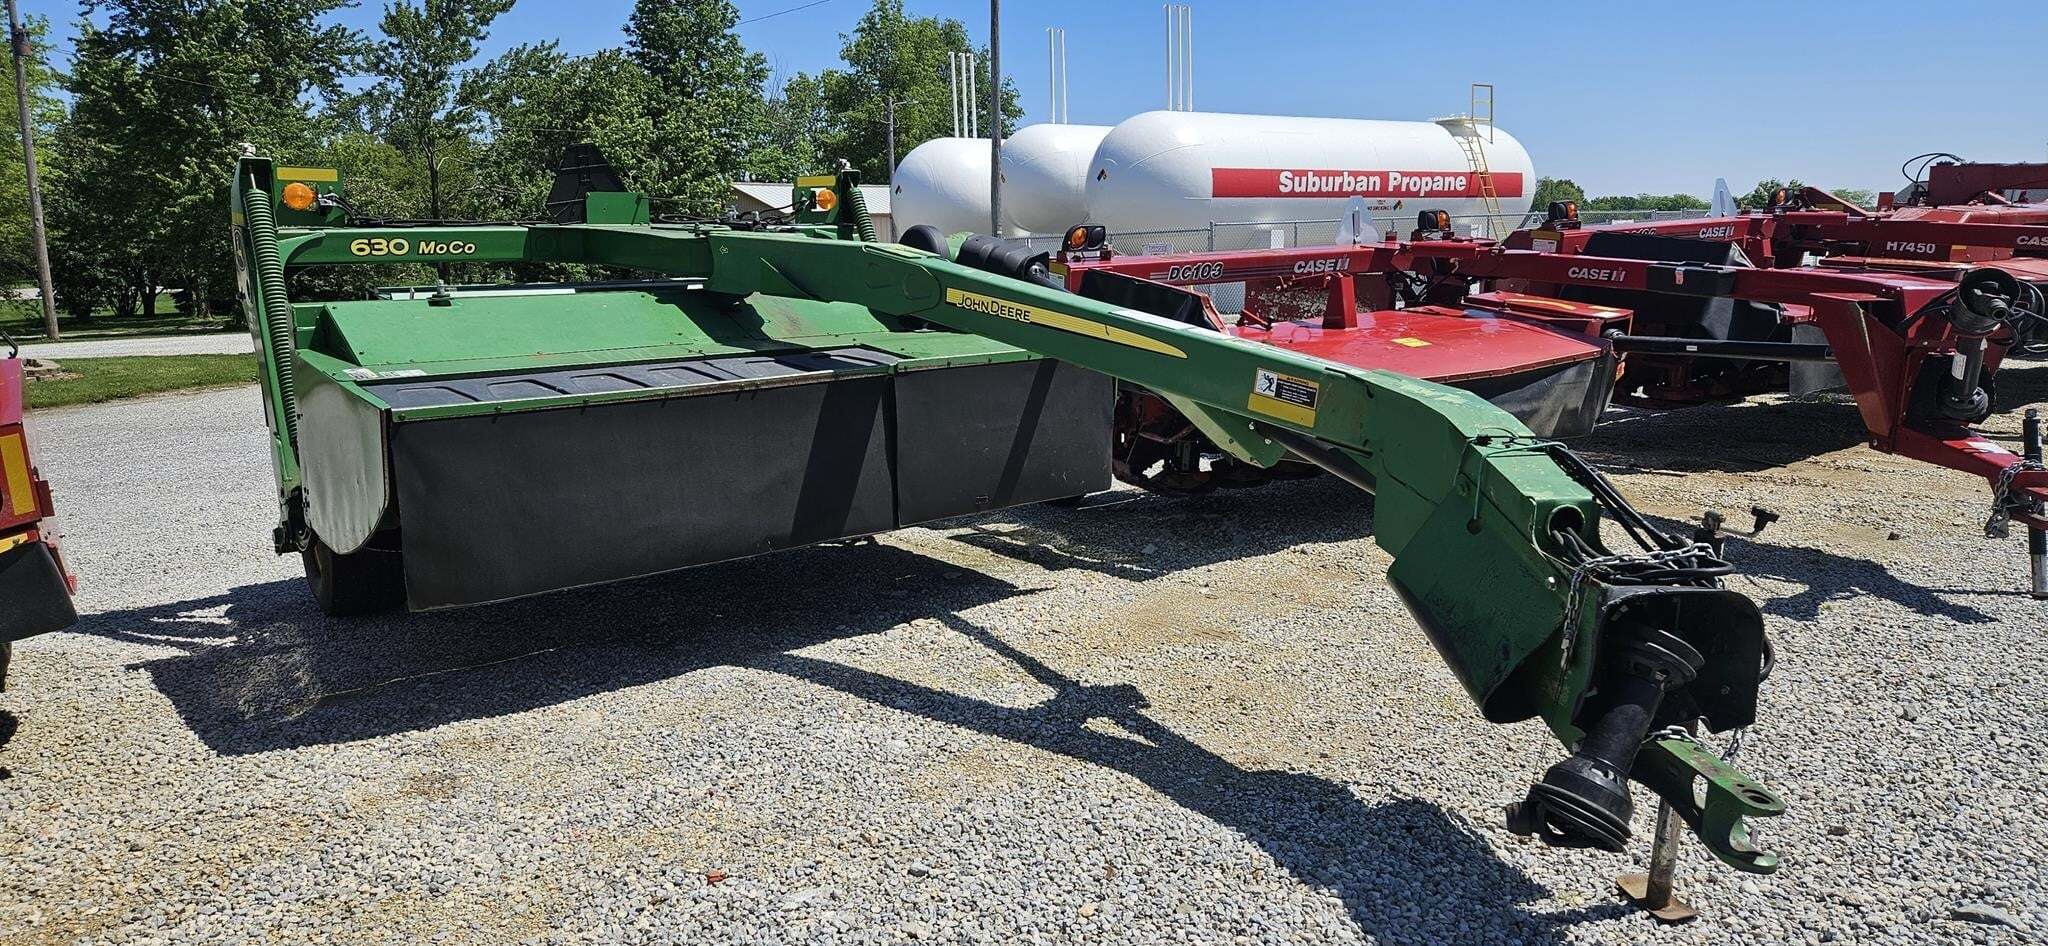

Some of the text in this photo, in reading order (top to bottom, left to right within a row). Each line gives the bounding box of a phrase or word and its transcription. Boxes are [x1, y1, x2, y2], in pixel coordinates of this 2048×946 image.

[1279, 171, 1467, 197] Suburban Propane
[350, 238, 476, 256] 630 MoCo
[1886, 241, 1936, 254] H7450
[1168, 261, 1224, 281] DC103
[1568, 267, 1611, 280] CASE
